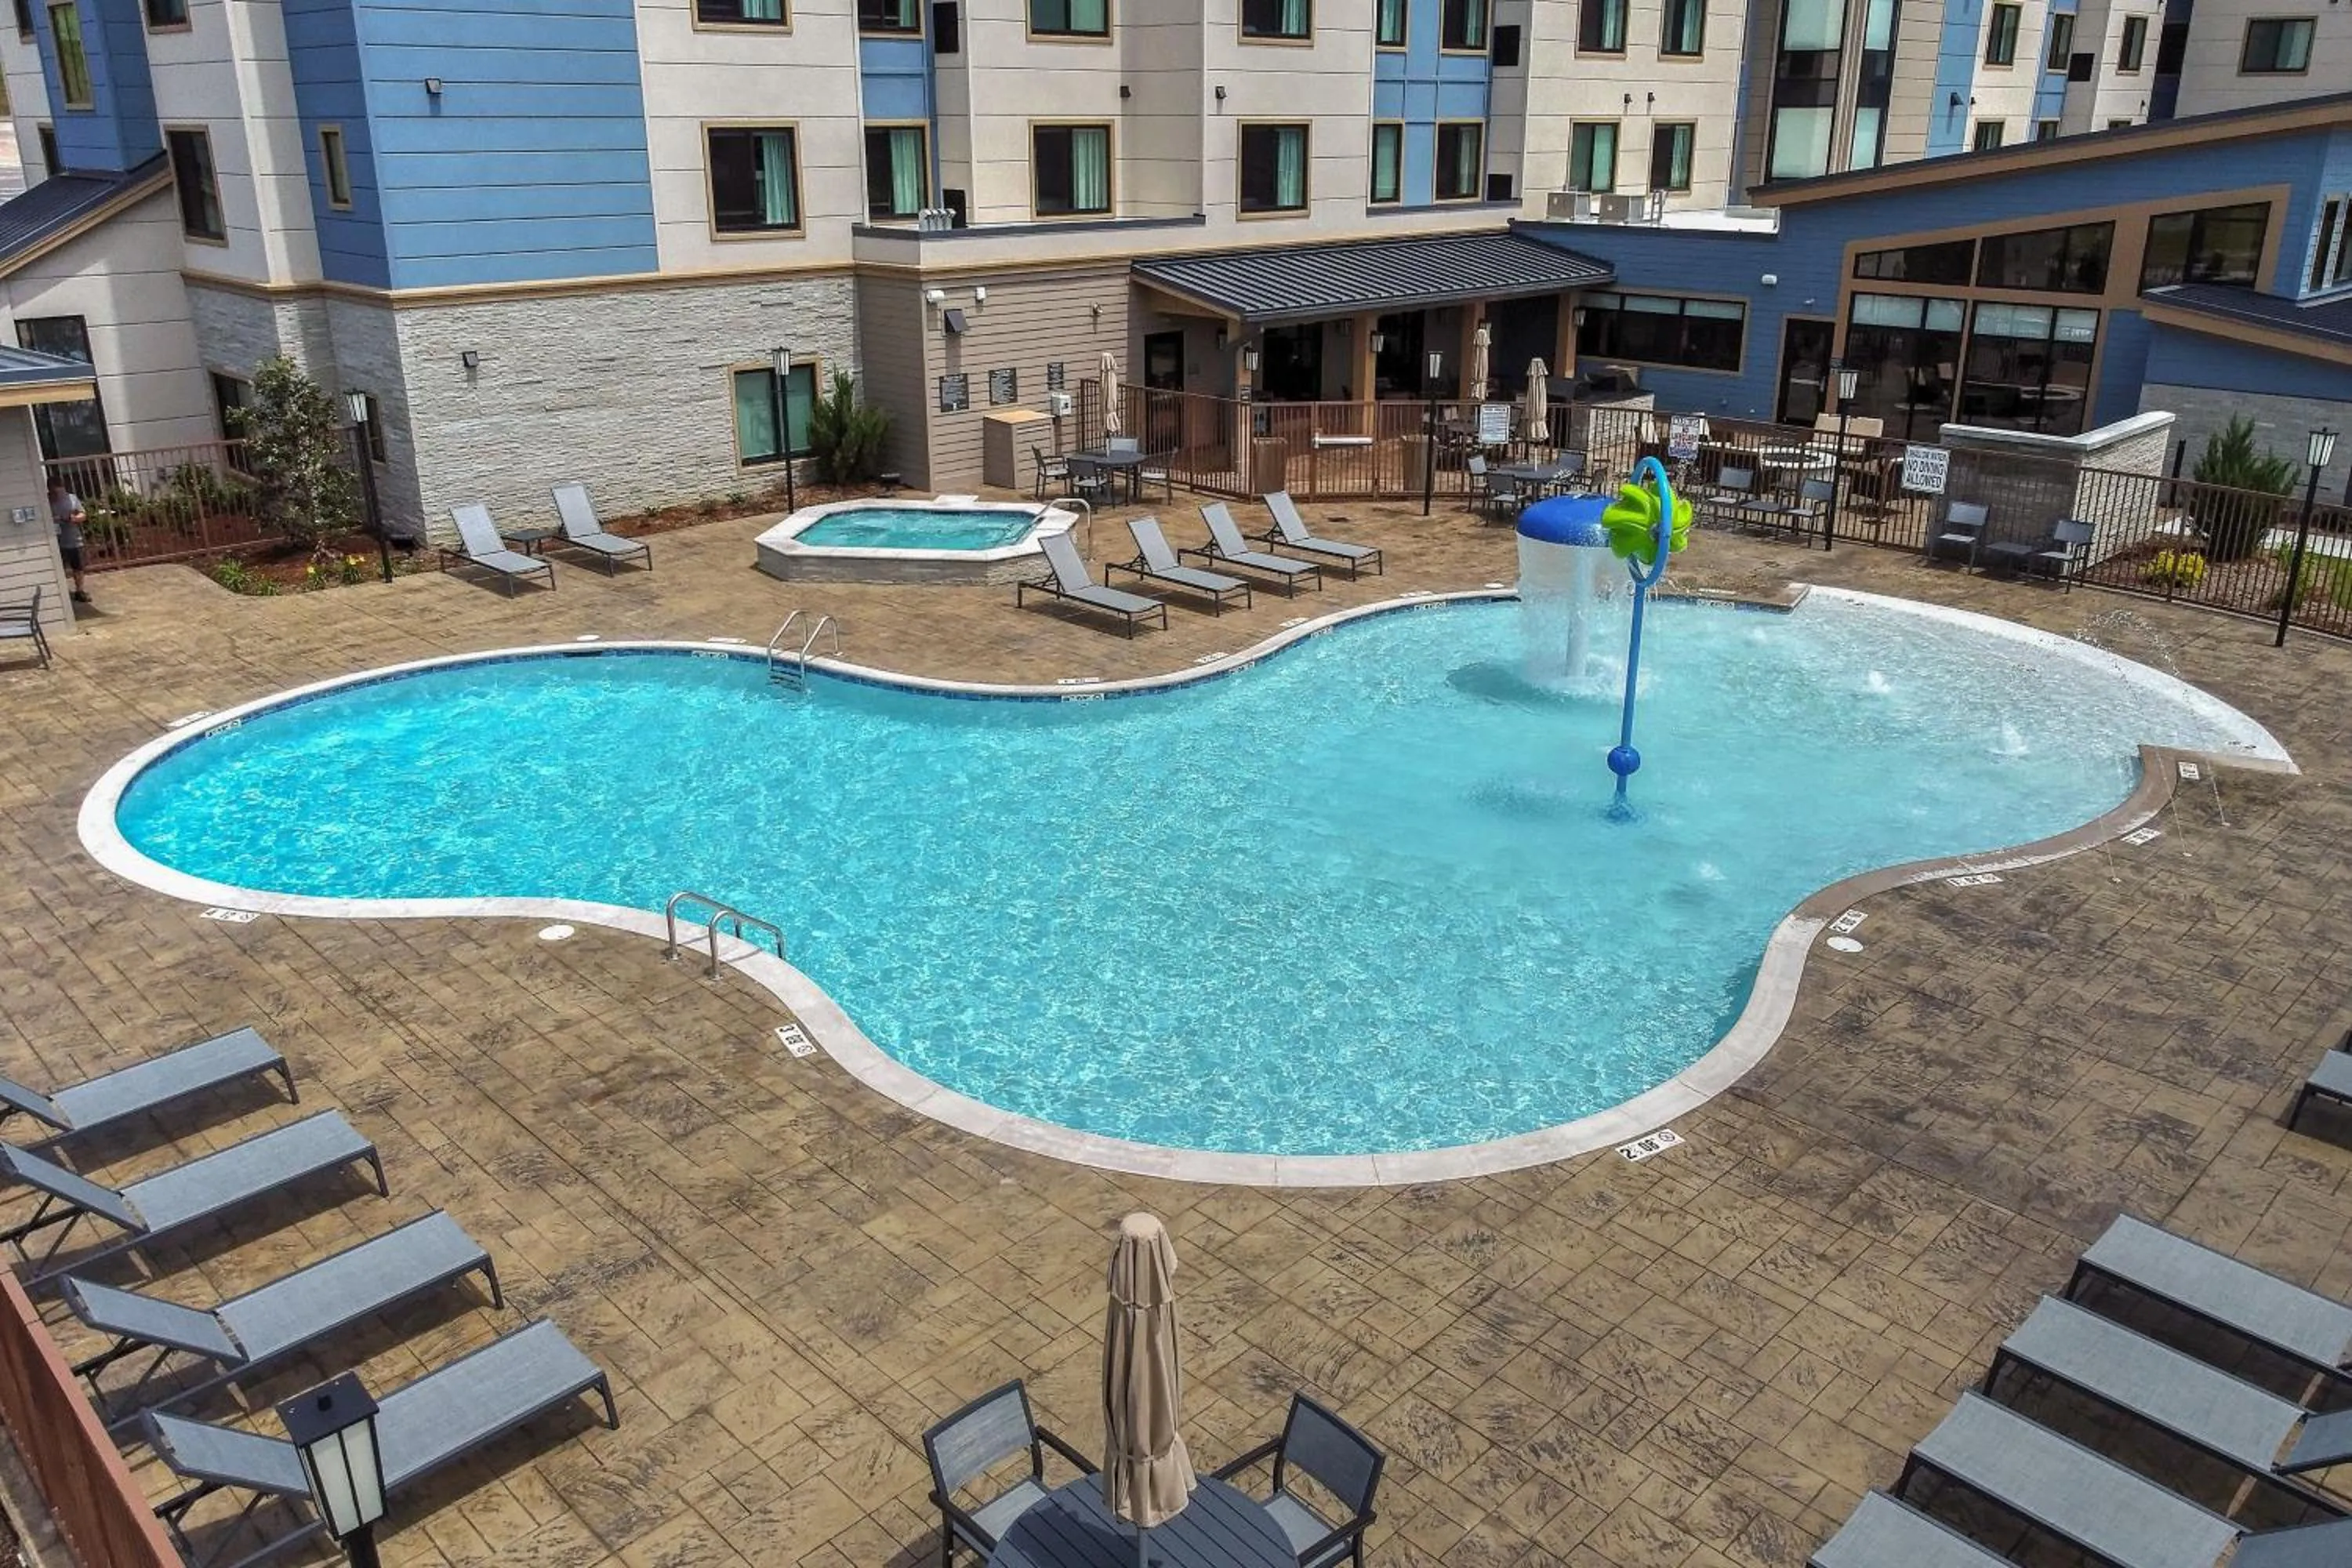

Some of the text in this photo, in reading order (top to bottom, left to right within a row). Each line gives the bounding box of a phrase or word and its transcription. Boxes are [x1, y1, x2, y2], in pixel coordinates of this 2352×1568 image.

[1907, 459, 1944, 475] NO DIVING
[1907, 473, 1942, 488] ALLOWED
